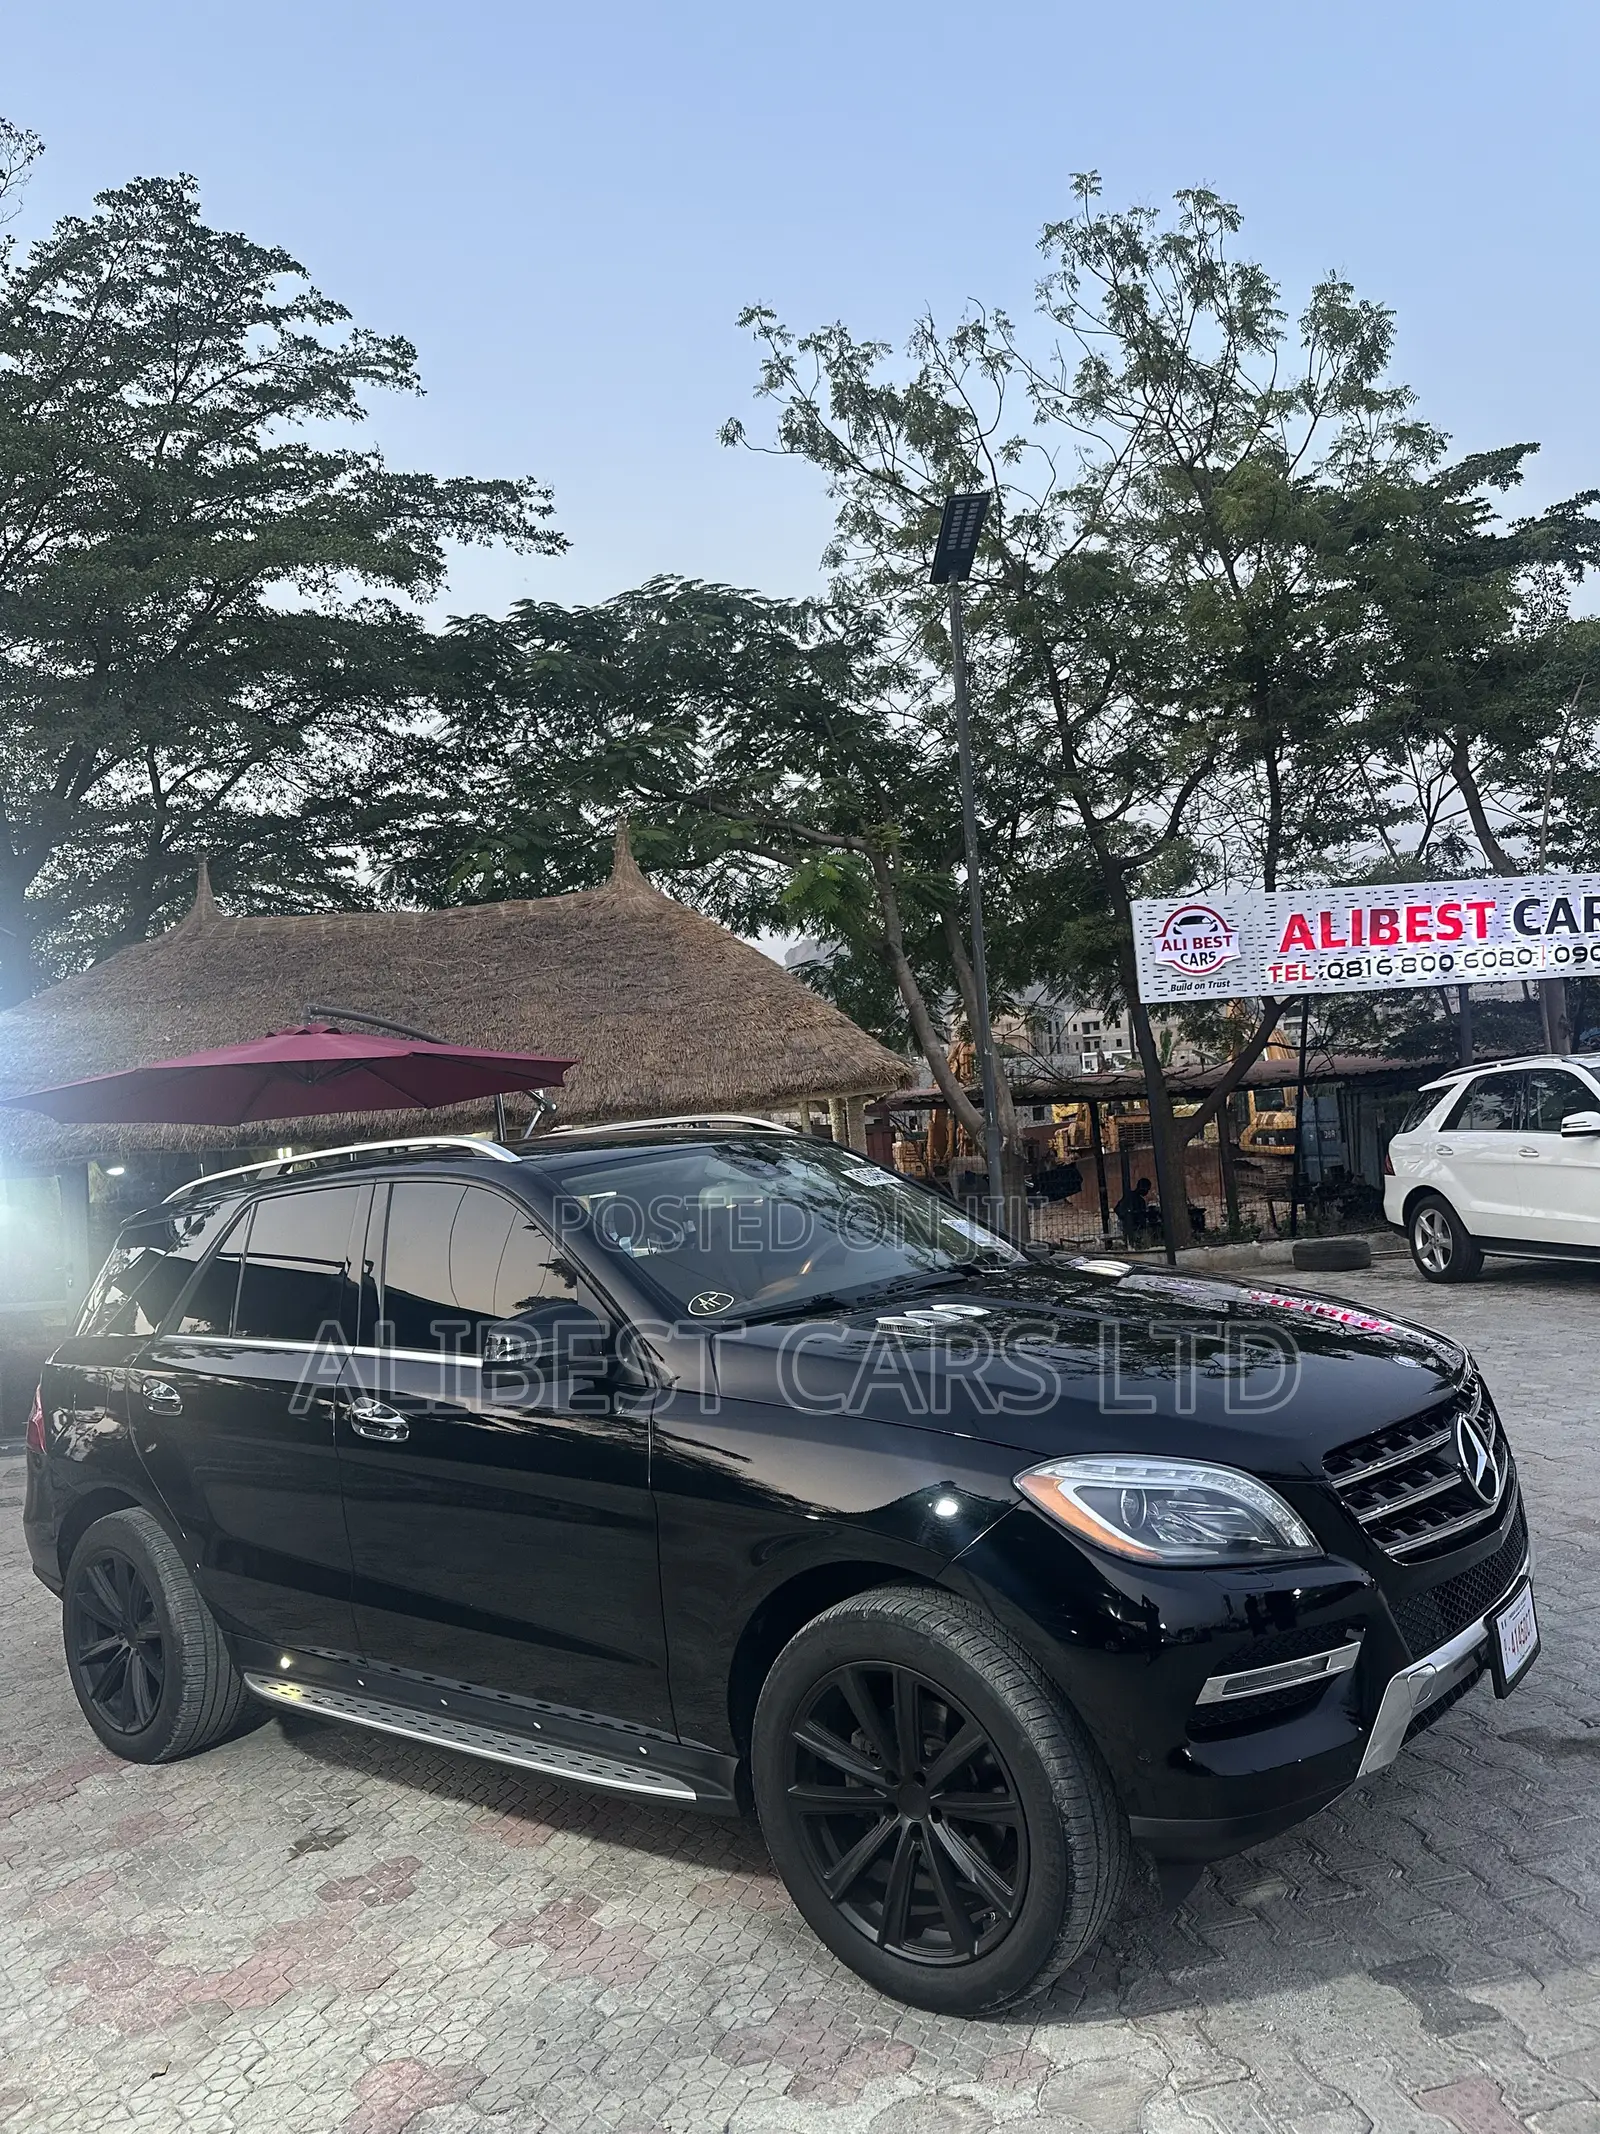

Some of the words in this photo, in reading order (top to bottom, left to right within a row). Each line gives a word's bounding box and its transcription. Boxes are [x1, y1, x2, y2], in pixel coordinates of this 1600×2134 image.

[1279, 901, 1495, 952] ALIBEST
[1161, 939, 1187, 951] ALI
[1193, 935, 1233, 949] BEST
[1180, 951, 1216, 966] CARS
[1401, 954, 1454, 973] 800
[1464, 949, 1532, 968] 6080
[1170, 982, 1193, 992] Build
[1208, 980, 1231, 989] Trust
